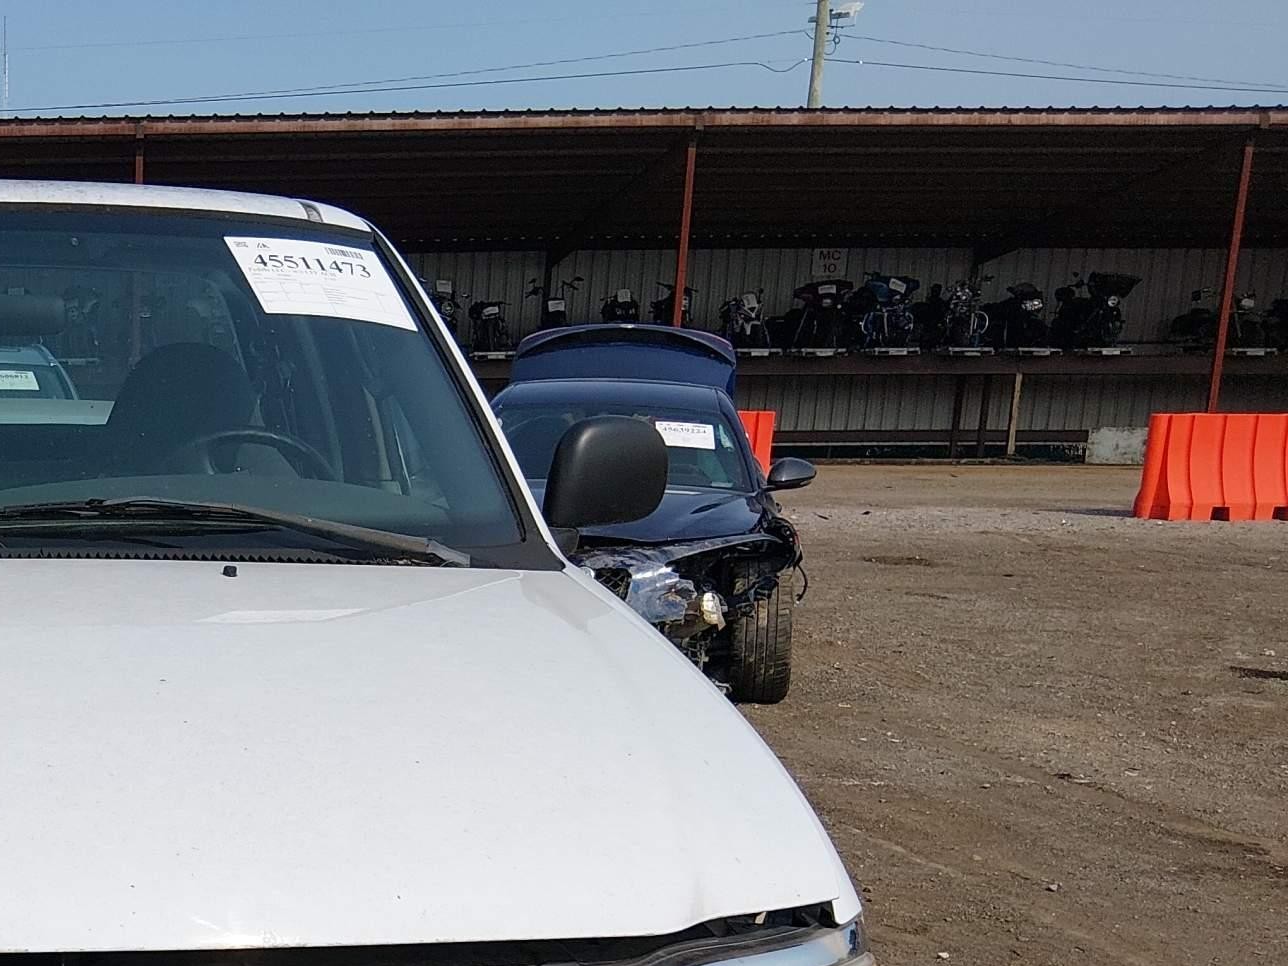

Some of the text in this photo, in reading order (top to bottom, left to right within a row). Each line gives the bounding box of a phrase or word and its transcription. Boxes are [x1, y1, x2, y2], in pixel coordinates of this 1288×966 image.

[818, 249, 841, 261] MC
[254, 253, 372, 279] 45511473
[823, 263, 837, 273] 10
